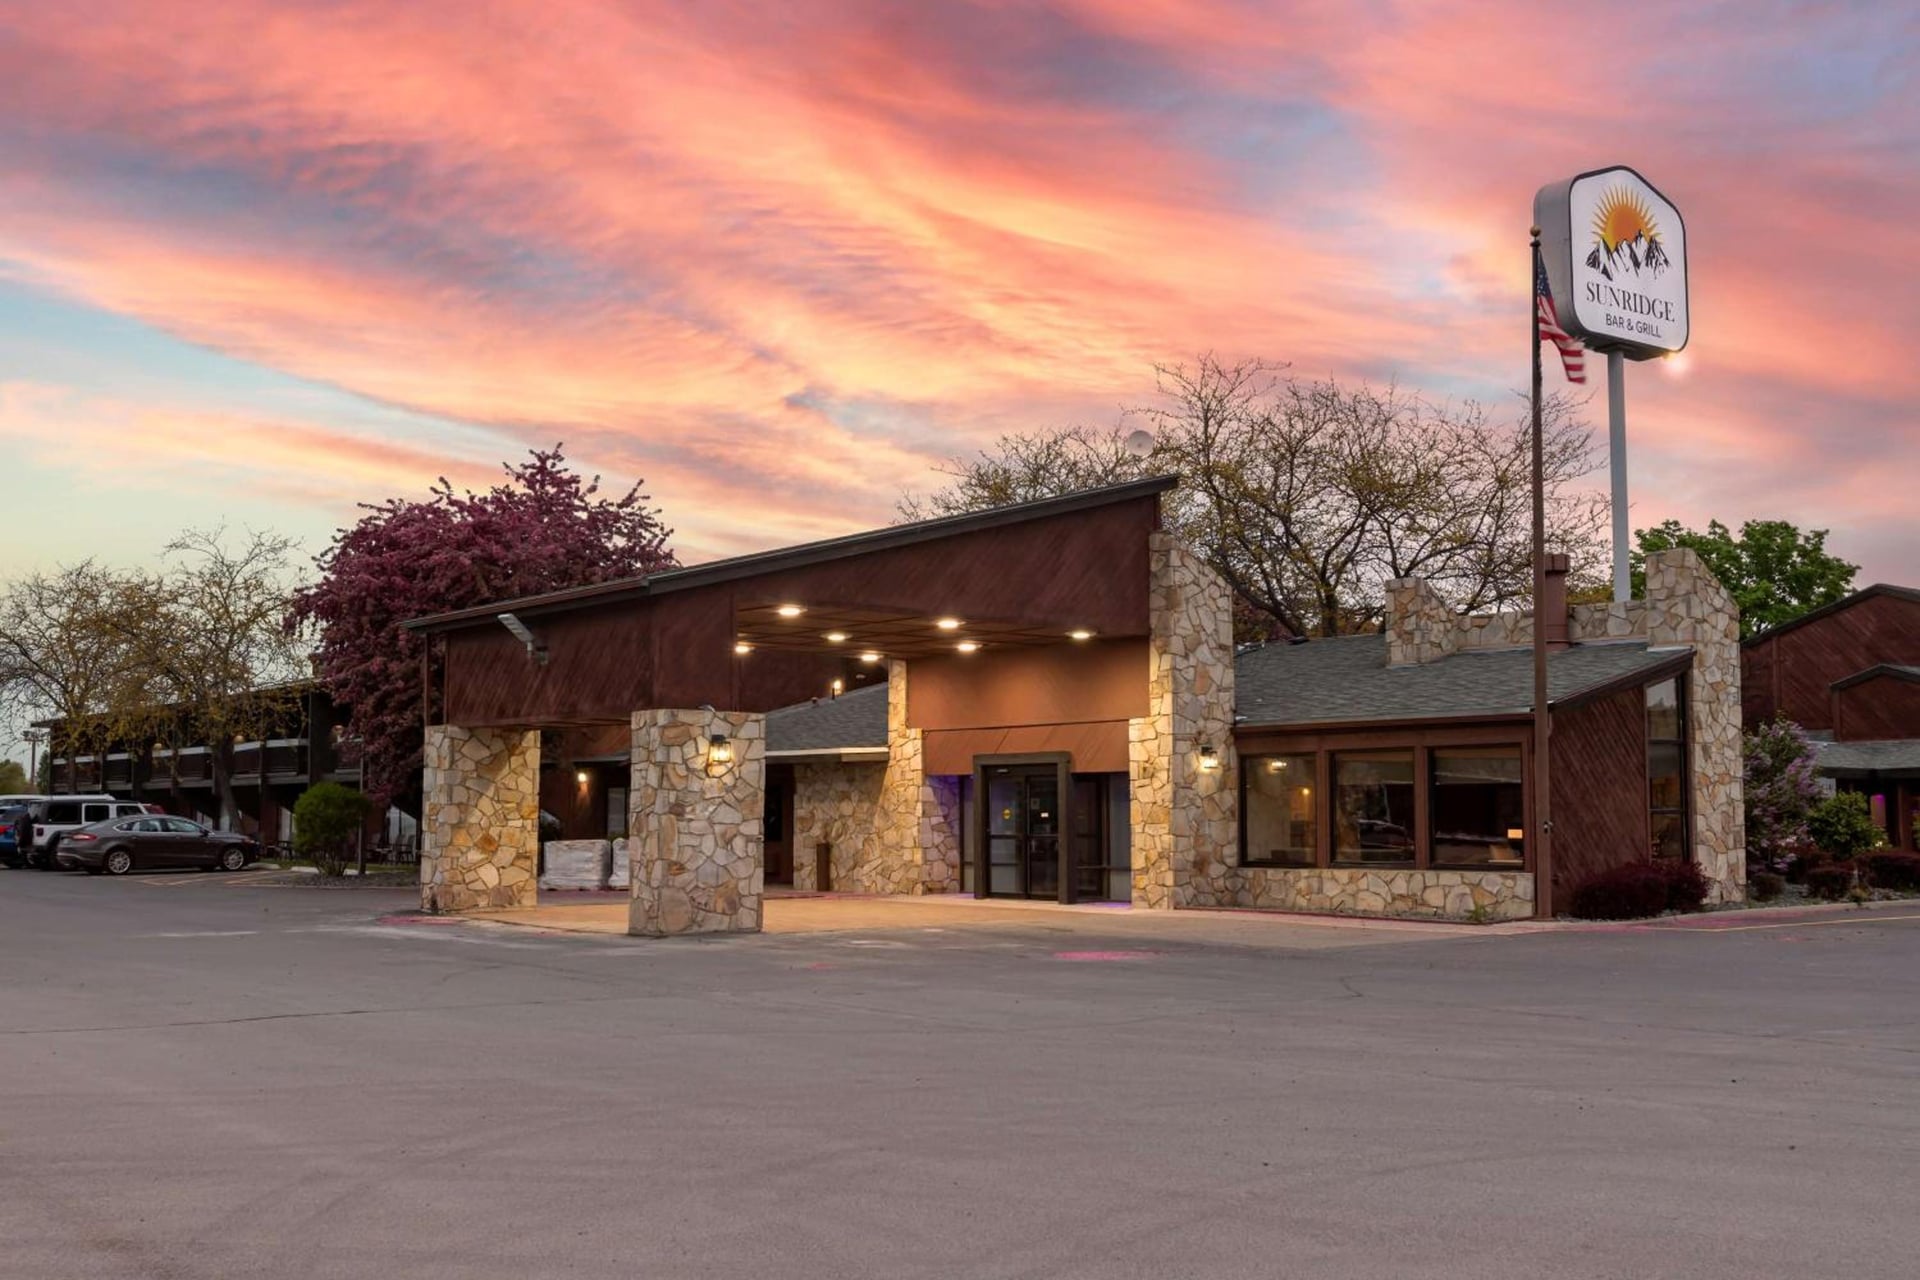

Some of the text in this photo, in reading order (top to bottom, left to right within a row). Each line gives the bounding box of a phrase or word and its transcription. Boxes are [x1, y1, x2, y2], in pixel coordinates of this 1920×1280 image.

[1586, 281, 1675, 322] SUNRIDGE
[1605, 313, 1662, 338] BAR & GRILL
